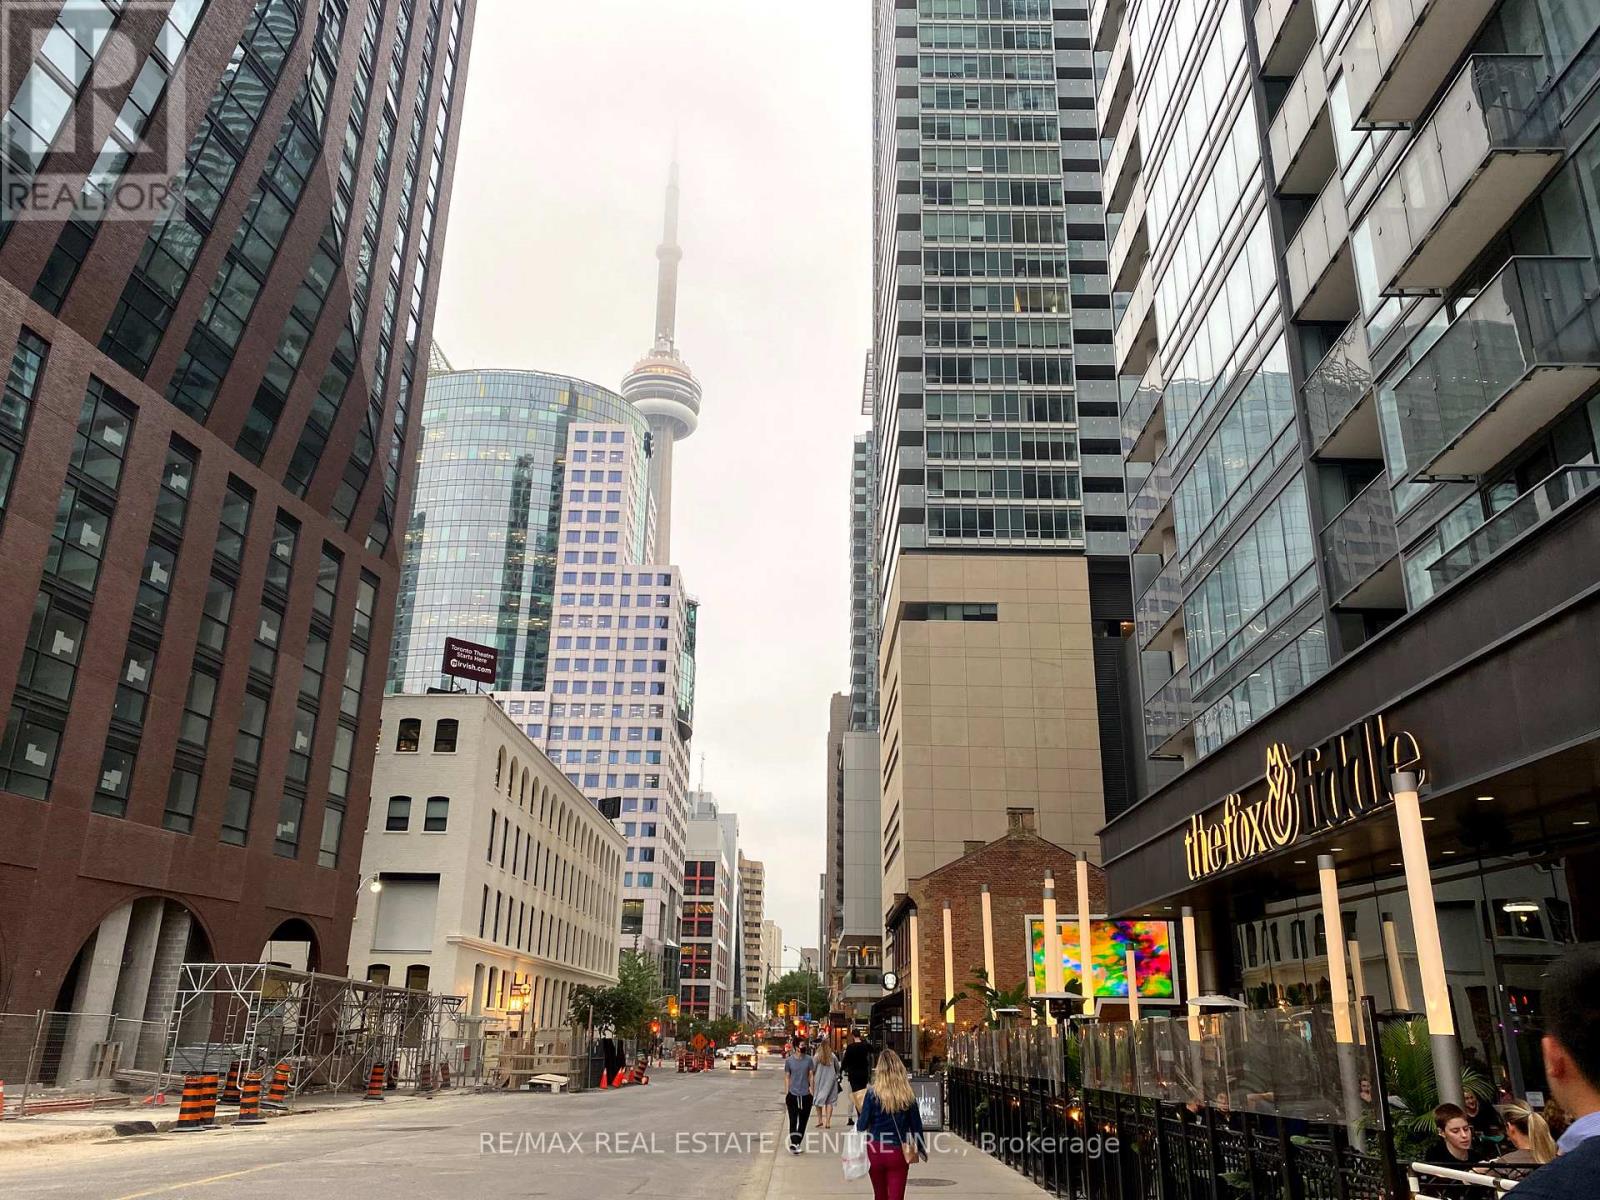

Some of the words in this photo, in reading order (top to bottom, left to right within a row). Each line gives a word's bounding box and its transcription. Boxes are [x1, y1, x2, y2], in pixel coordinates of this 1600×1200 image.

[451, 644, 473, 654] Toronto
[473, 650, 494, 660] Theatre
[456, 652, 473, 660] Starts
